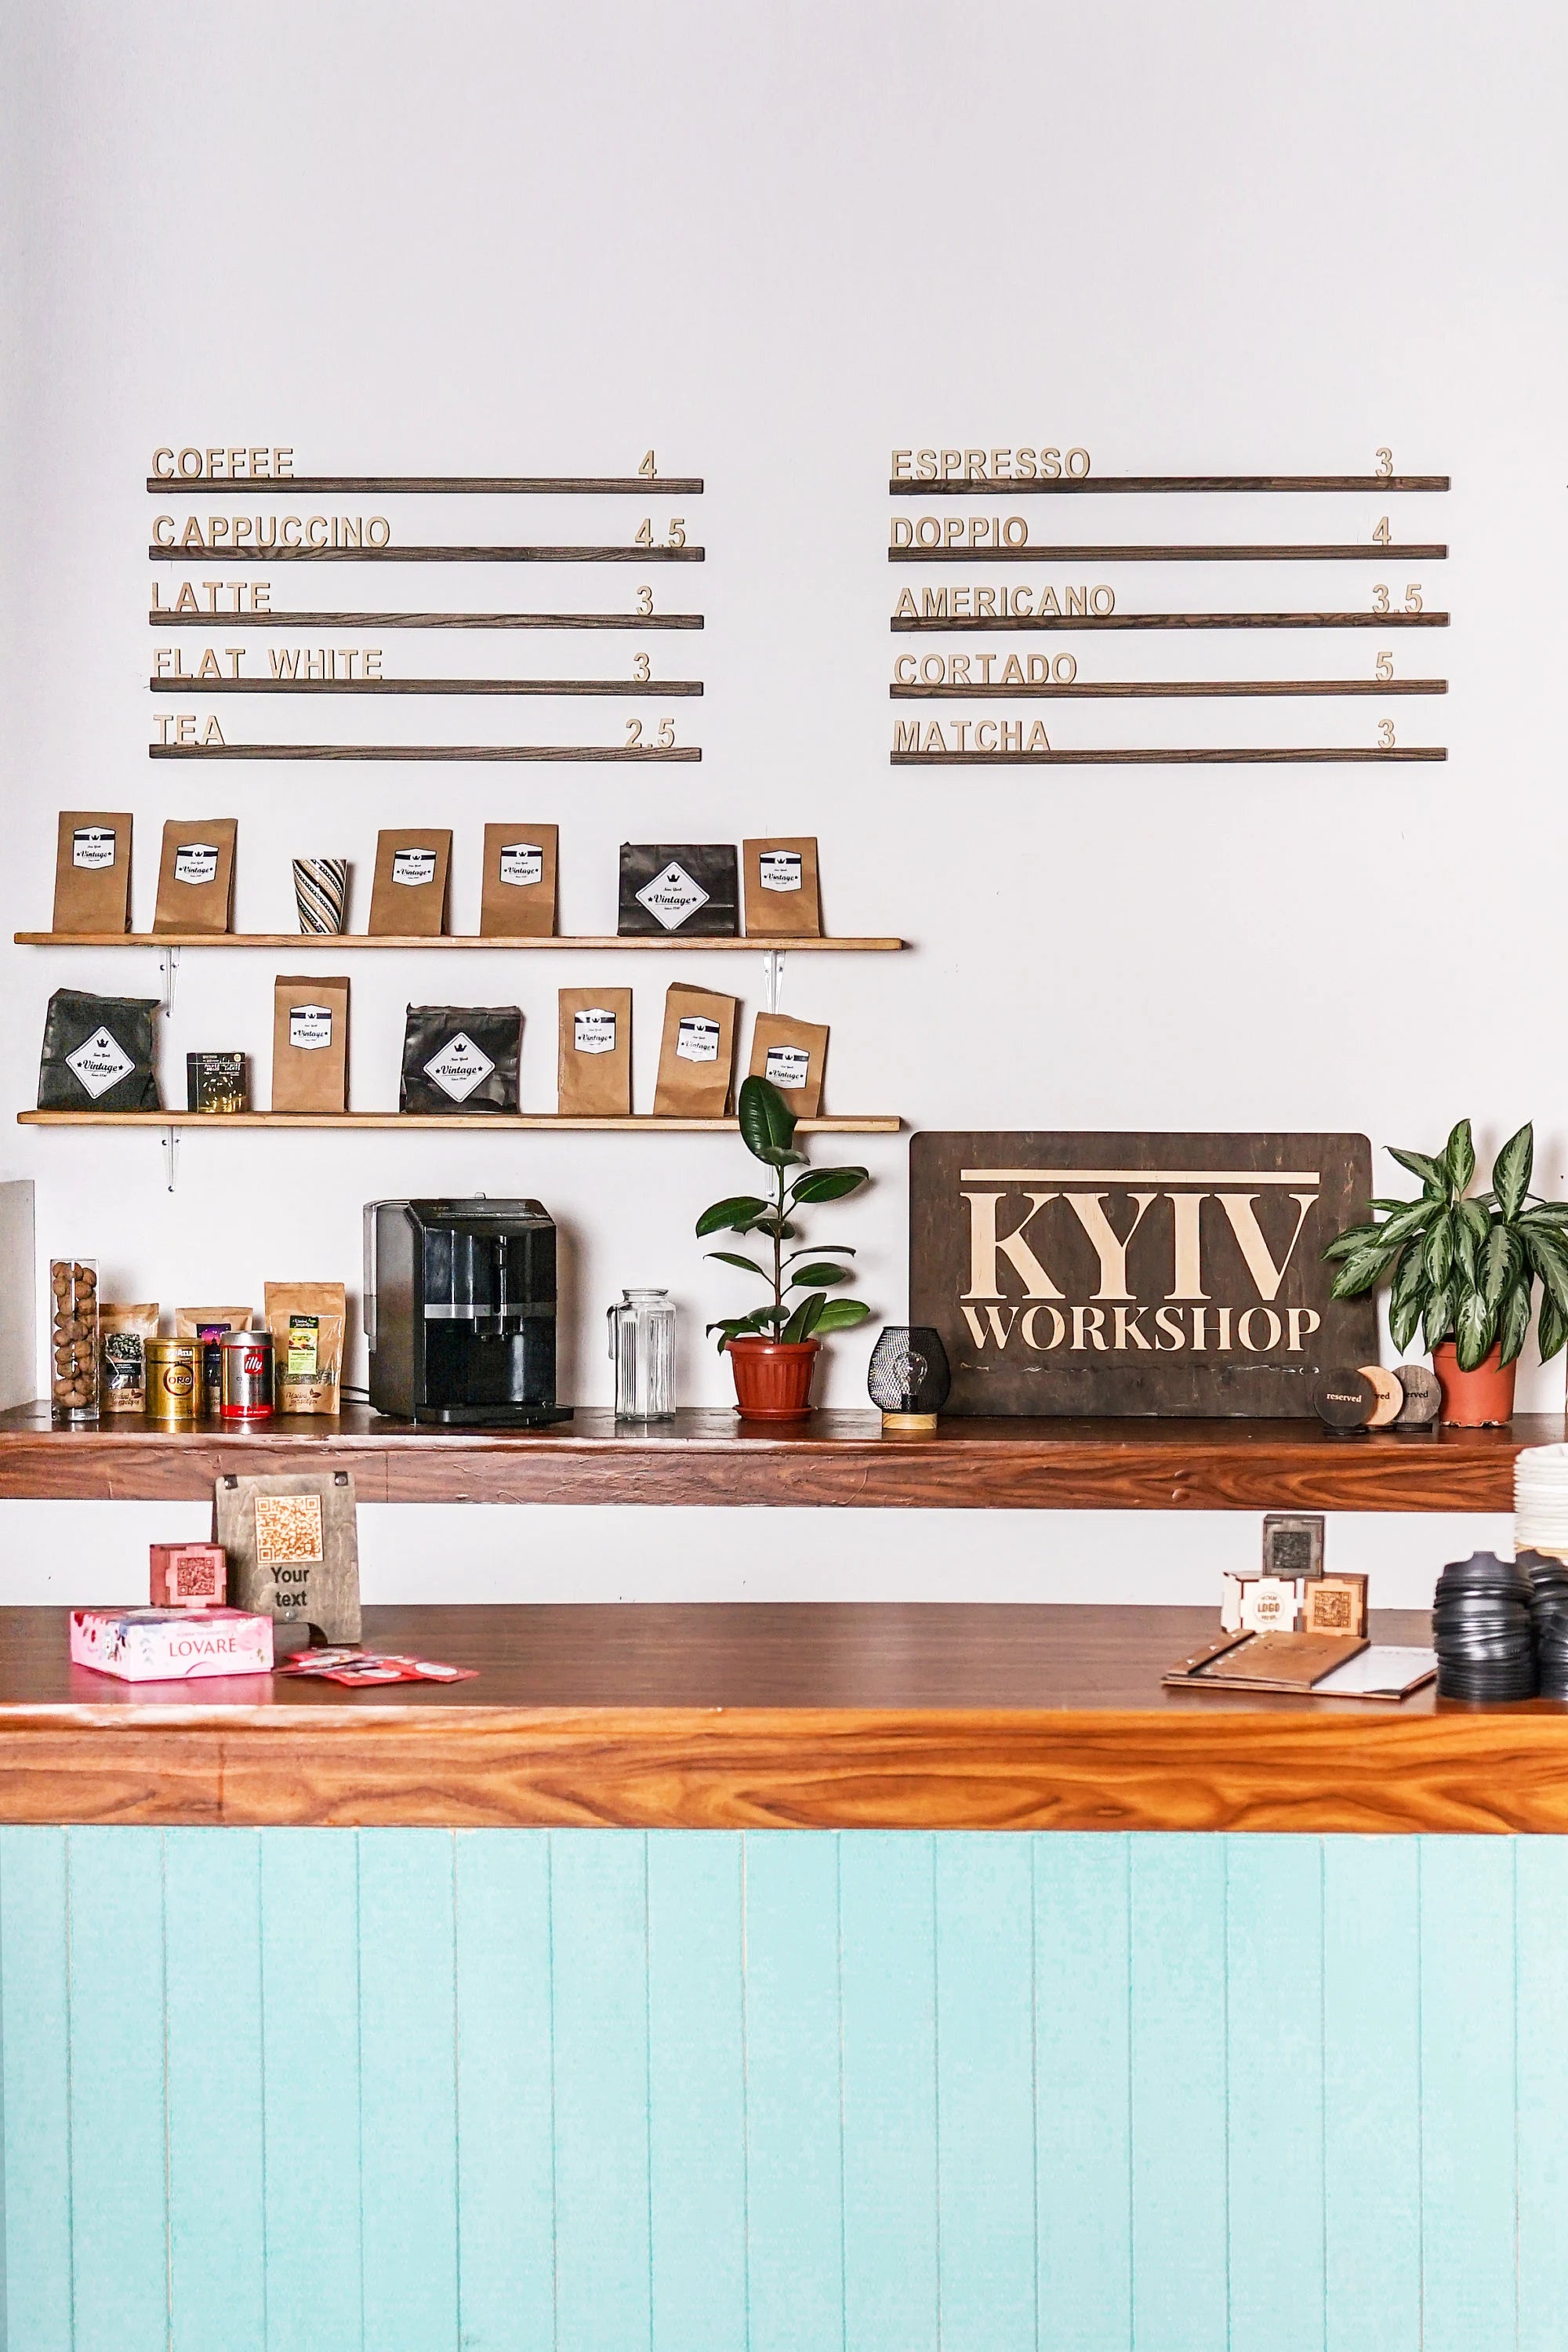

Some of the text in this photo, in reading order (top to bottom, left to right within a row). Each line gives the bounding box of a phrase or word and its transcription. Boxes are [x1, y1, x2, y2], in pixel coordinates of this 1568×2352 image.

[152, 448, 658, 479] COFFEE 4
[891, 448, 1394, 479] ESPRESSO 3
[152, 517, 687, 548] CAPPUCCINO 4.5
[891, 517, 1392, 547] DOPPIO 4
[151, 583, 653, 615] LATTE 3
[895, 584, 1423, 618] AMERICANO 3.5
[153, 649, 650, 682] FLAT WHITE 3
[894, 652, 1394, 685] CORTADO 5
[153, 715, 676, 749] TEA 2.5
[893, 719, 1396, 753] MATCHA 3
[80, 850, 107, 859] Vintage
[183, 866, 209, 875] Vintage
[508, 866, 535, 875] Vintage
[768, 873, 795, 883] Vintage
[653, 894, 691, 906] Vintage
[296, 1029, 325, 1039] Vintage
[581, 1033, 608, 1043] Vintage
[82, 1059, 118, 1074] Vintage
[441, 1065, 477, 1077] Vintage
[772, 1069, 800, 1080] Vintage
[960, 1192, 1319, 1301] KYIV
[961, 1306, 1321, 1352] WORKSHOP
[245, 1356, 263, 1373] illy
[1327, 1392, 1363, 1403] reserved
[1406, 1390, 1428, 1399] erved
[270, 1566, 310, 1584] Your
[275, 1590, 308, 1608] text
[1258, 1602, 1280, 1613] LOGO
